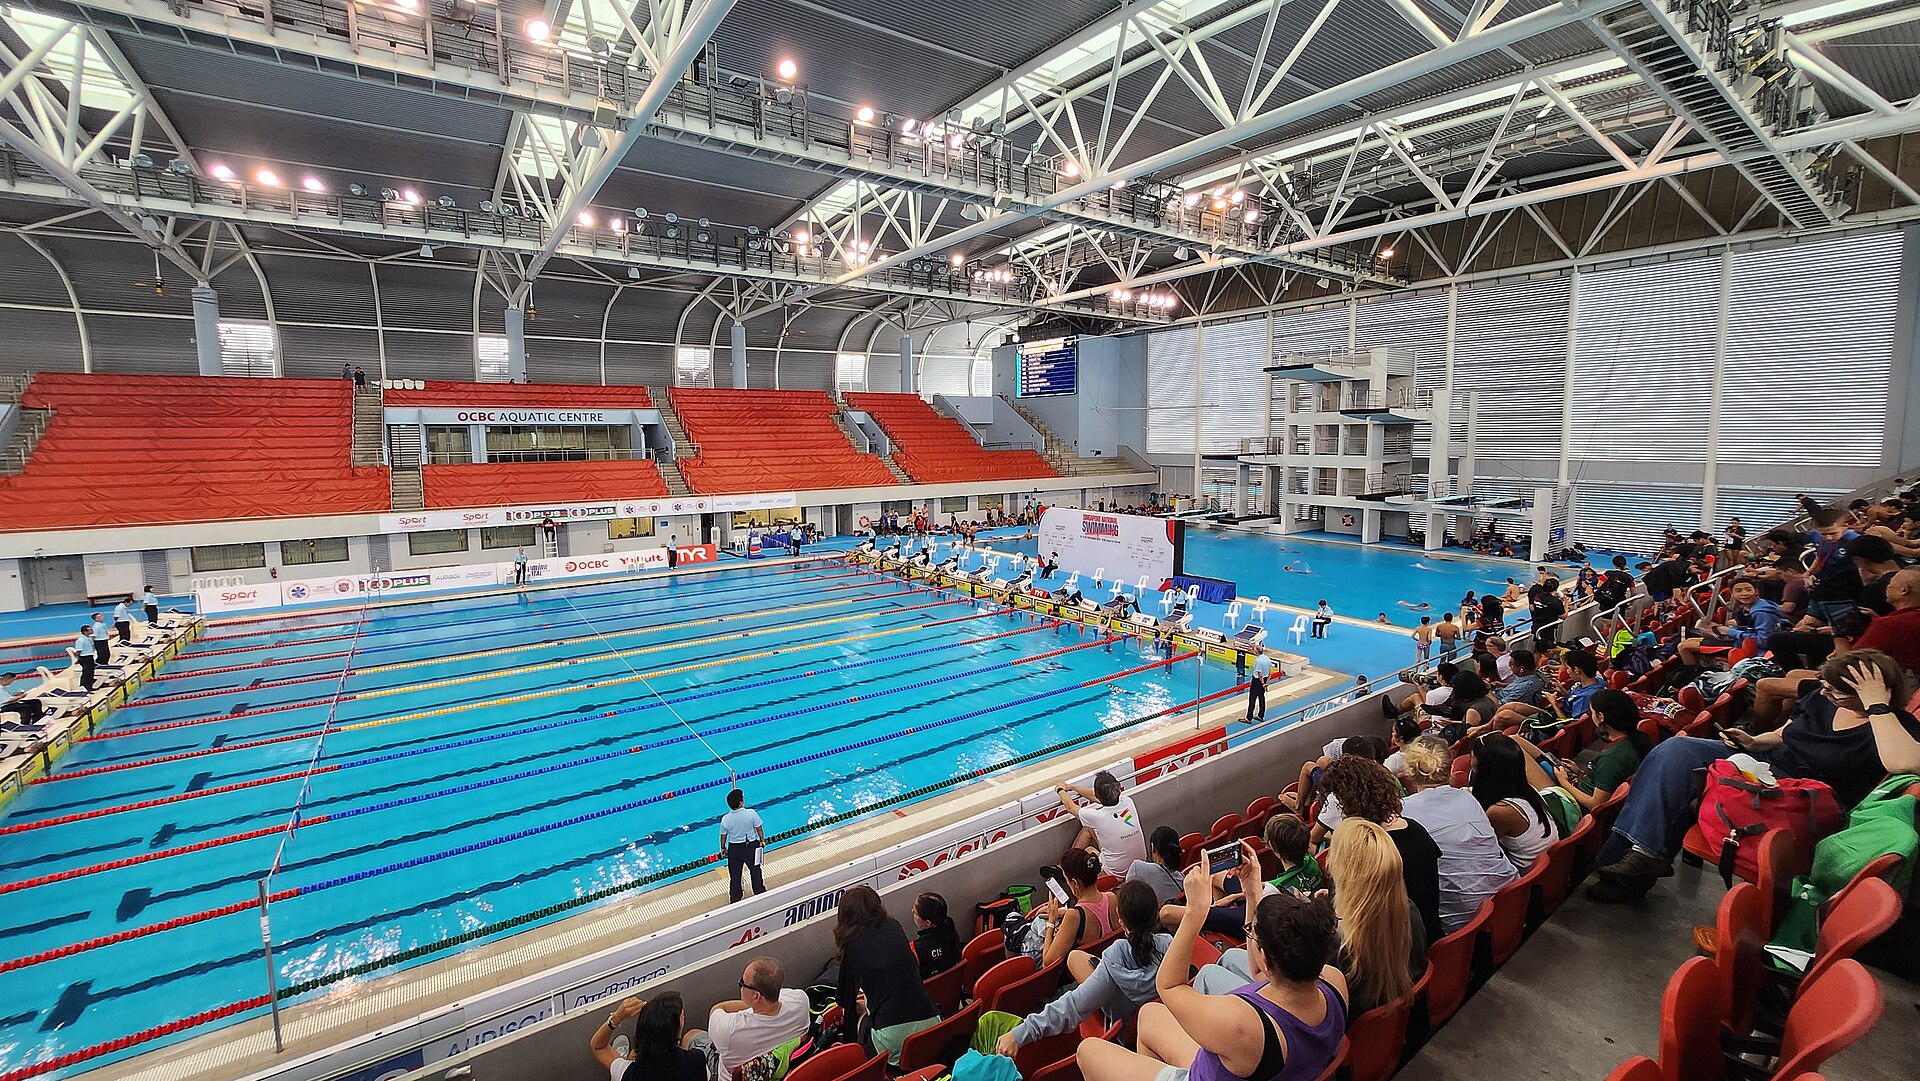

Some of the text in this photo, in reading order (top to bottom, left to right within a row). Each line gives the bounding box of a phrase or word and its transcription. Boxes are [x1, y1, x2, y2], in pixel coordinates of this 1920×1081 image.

[457, 412, 604, 423] OCBC AQUATIC CENTRE
[398, 516, 427, 526] Sport
[463, 512, 489, 522] Sport
[676, 547, 709, 562] TYR
[578, 559, 609, 570] OCBC
[362, 576, 429, 593] 100PLUS
[220, 590, 258, 602] Sport
